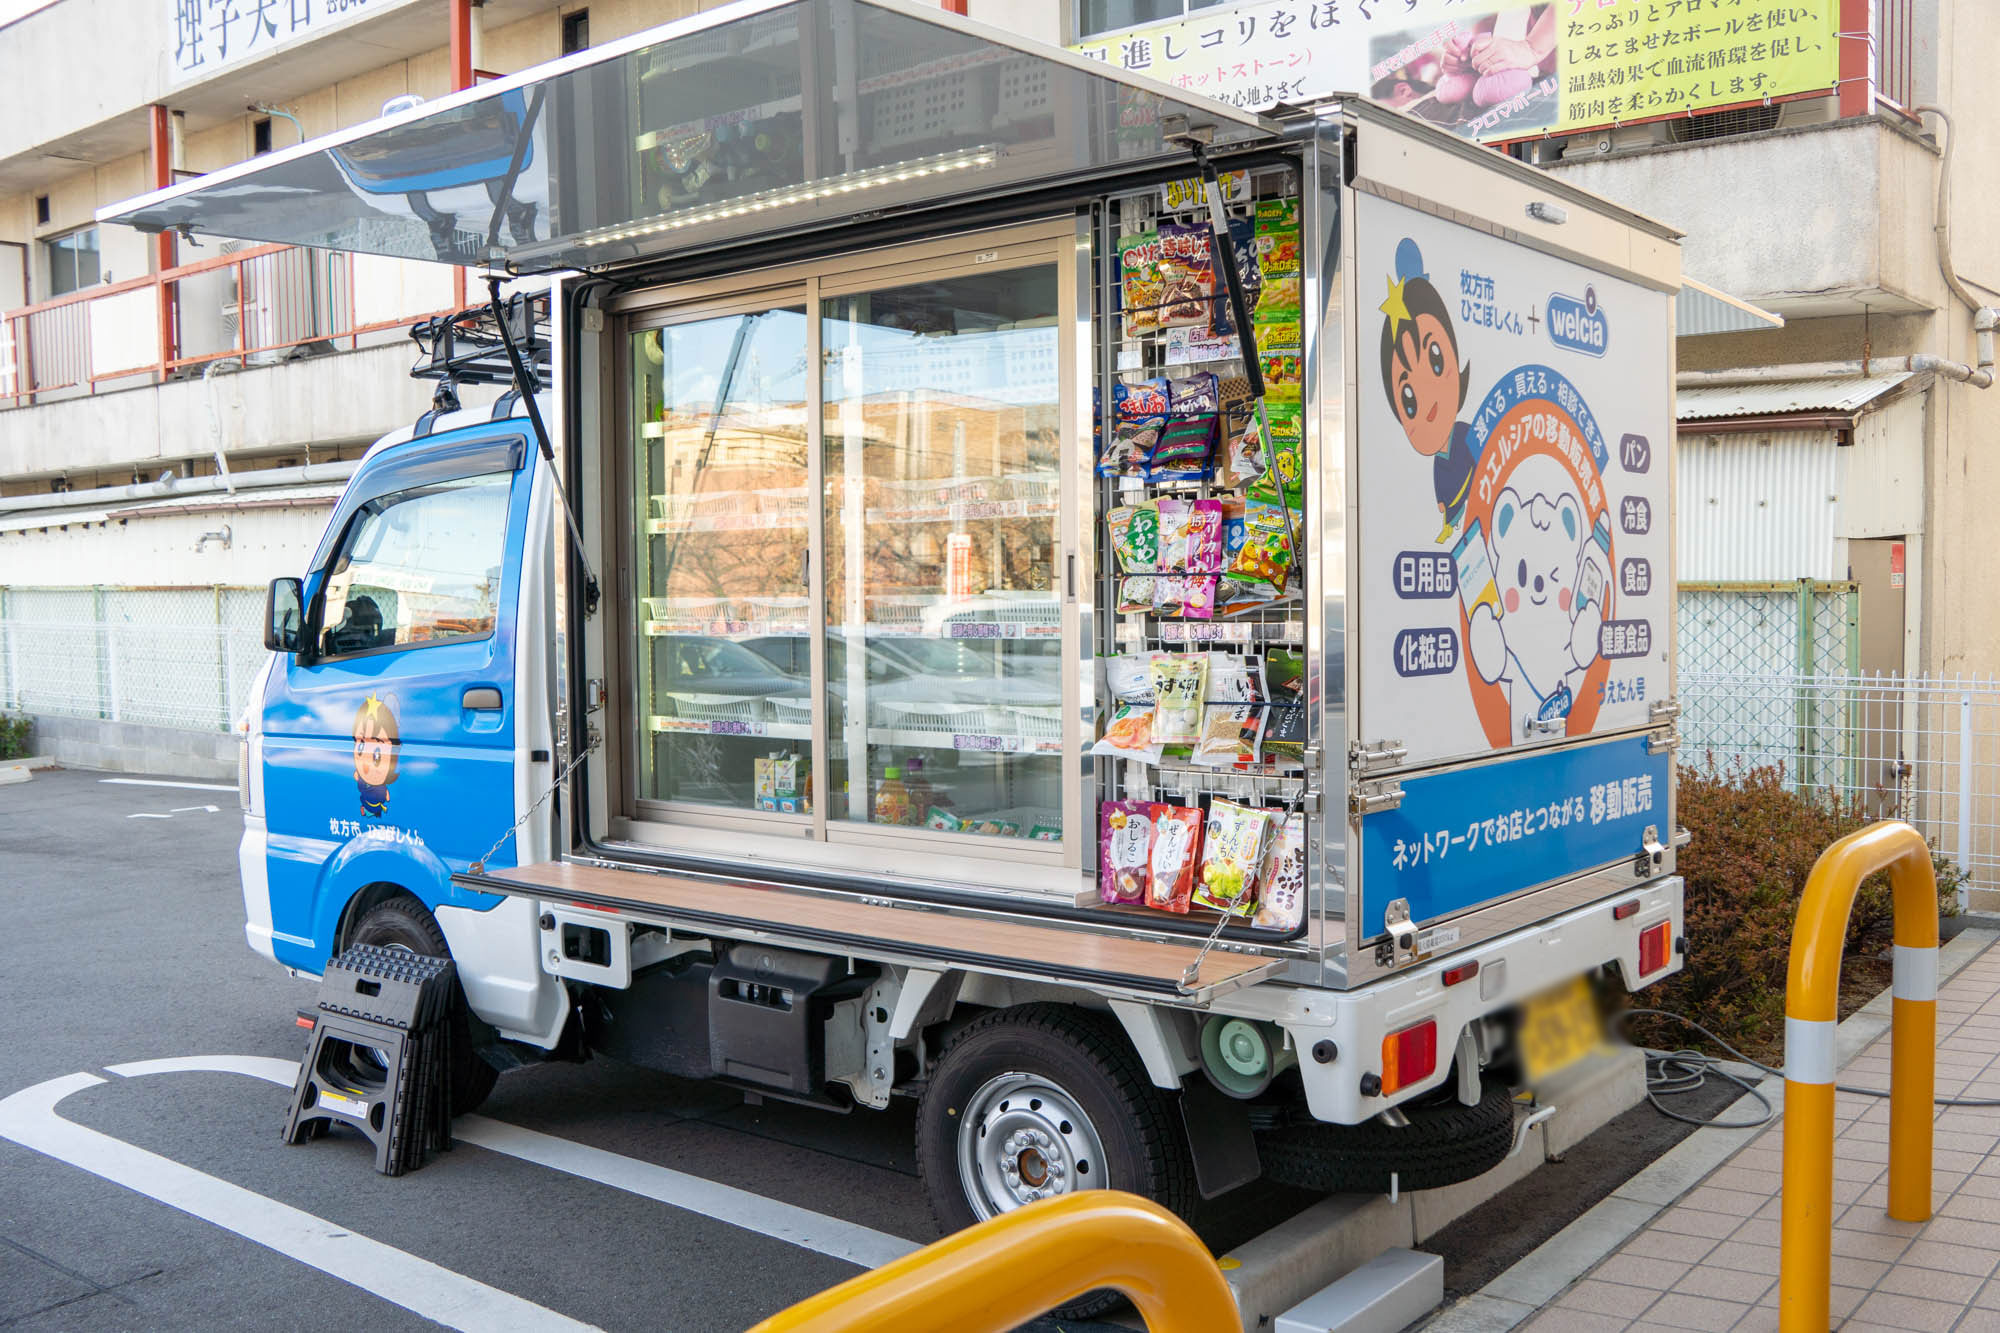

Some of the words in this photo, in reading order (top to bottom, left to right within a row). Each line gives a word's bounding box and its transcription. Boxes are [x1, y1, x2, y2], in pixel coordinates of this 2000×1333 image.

[1568, 8, 1820, 65] しみこませたボールを使い、
[1568, 36, 1823, 93] 温熱効果で血流循環を促し、
[1467, 77, 1559, 137] アロマボール
[1568, 72, 1778, 120] 筋肉を柔らかくします。
[1460, 268, 1495, 302] 枚方市
[1460, 299, 1524, 336] ひこぼしくん
[1551, 307, 1604, 347] welcia
[1473, 371, 1602, 458] 選べる・買える・相談できる
[1625, 440, 1647, 468] パン
[1624, 499, 1648, 531] 冷食
[1133, 515, 1155, 561] わかめ
[1400, 557, 1452, 592] 日用品
[1624, 561, 1648, 592] 食品
[1400, 633, 1452, 672] 化粧品
[1602, 623, 1649, 656] 健康食品
[1597, 676, 1646, 705] うえたん号
[329, 817, 362, 838] 枚方市
[1127, 818, 1141, 864] おしるこ
[1392, 796, 1585, 871] ネットワークでお店とつながる
[1588, 773, 1653, 826] 移動販売
